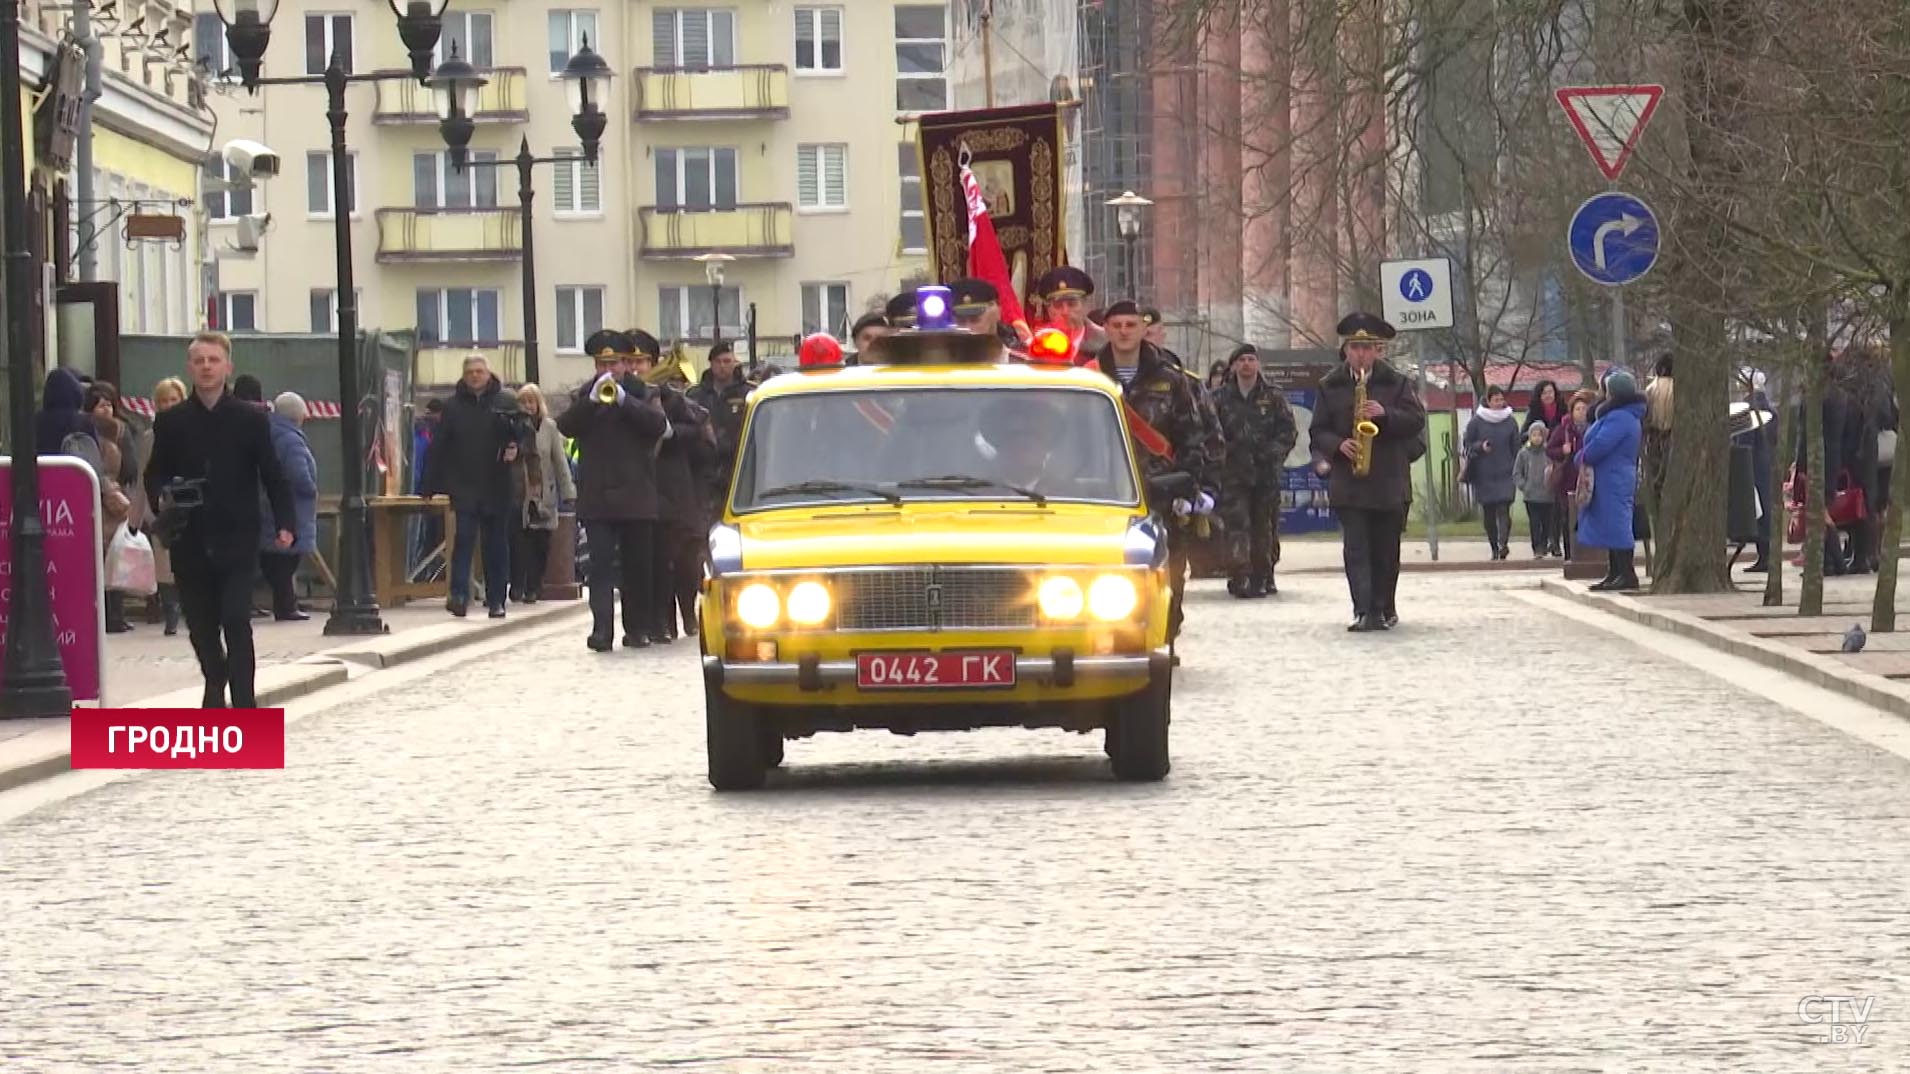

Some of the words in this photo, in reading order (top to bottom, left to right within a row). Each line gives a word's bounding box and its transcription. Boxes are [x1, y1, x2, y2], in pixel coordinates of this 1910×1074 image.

[1399, 310, 1437, 324] ЗОНА
[870, 657, 939, 683] 0442
[962, 655, 1001, 681] ГК
